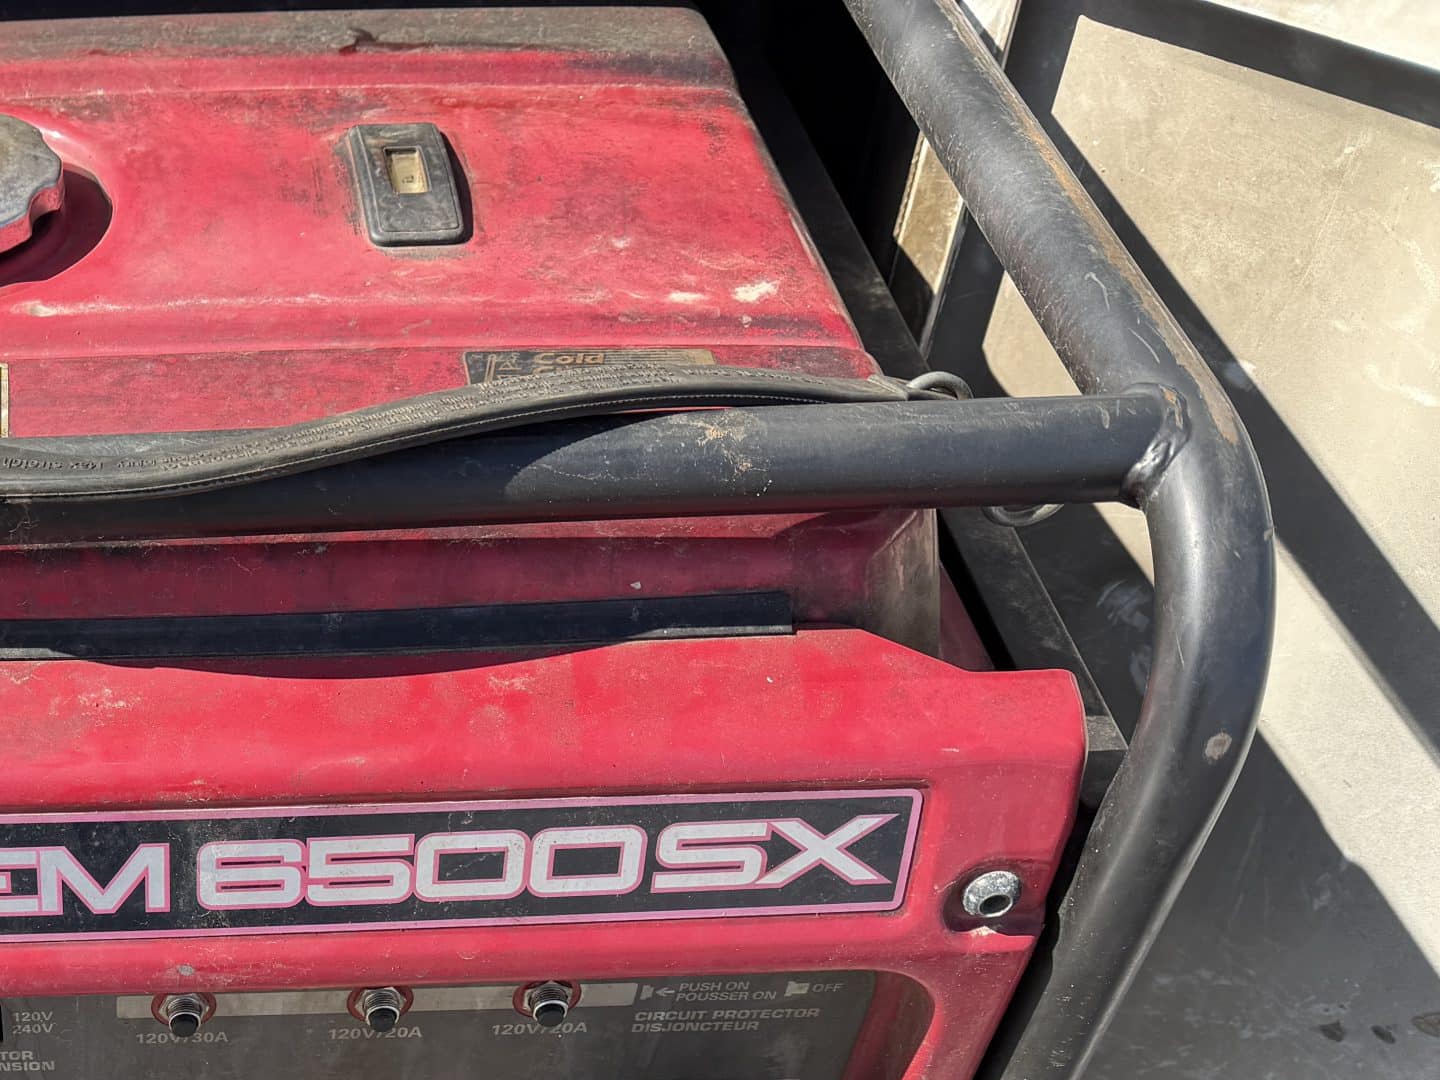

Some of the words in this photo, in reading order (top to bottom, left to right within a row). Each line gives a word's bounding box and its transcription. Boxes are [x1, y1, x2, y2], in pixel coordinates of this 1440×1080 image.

[678, 981, 723, 993] PUSH
[725, 980, 751, 991] ON
[812, 982, 845, 993] OFF
[675, 990, 750, 1002] POUSSER
[751, 989, 778, 1001] ON
[13, 1011, 55, 1022] 120V
[634, 1009, 708, 1022] CIRCUIT
[711, 1007, 821, 1020] PROTECTOR
[12, 1023, 57, 1035] 240V
[631, 1020, 761, 1033] DISJONCTEUR
